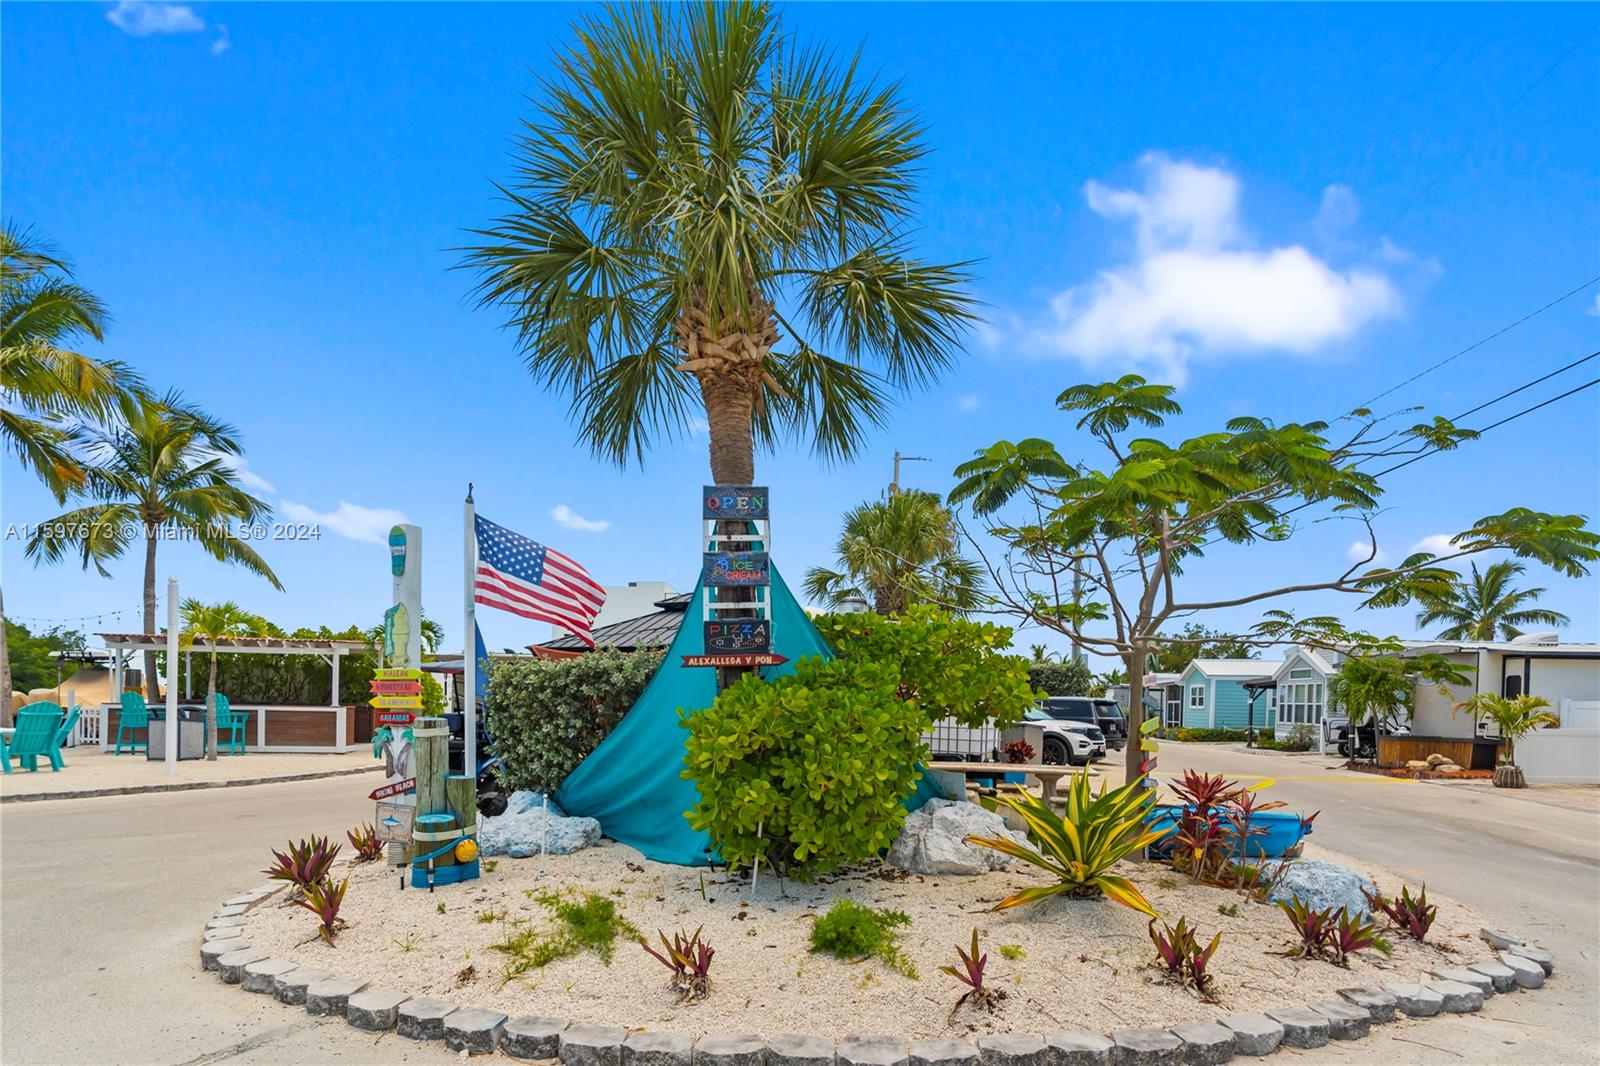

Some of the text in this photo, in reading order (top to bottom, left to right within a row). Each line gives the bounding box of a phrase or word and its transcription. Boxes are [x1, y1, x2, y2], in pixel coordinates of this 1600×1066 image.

[706, 495, 765, 510] OPEN
[732, 561, 754, 570] ICE
[725, 570, 763, 580] CREAM
[709, 623, 766, 636] PIZZA
[745, 656, 752, 665] Y
